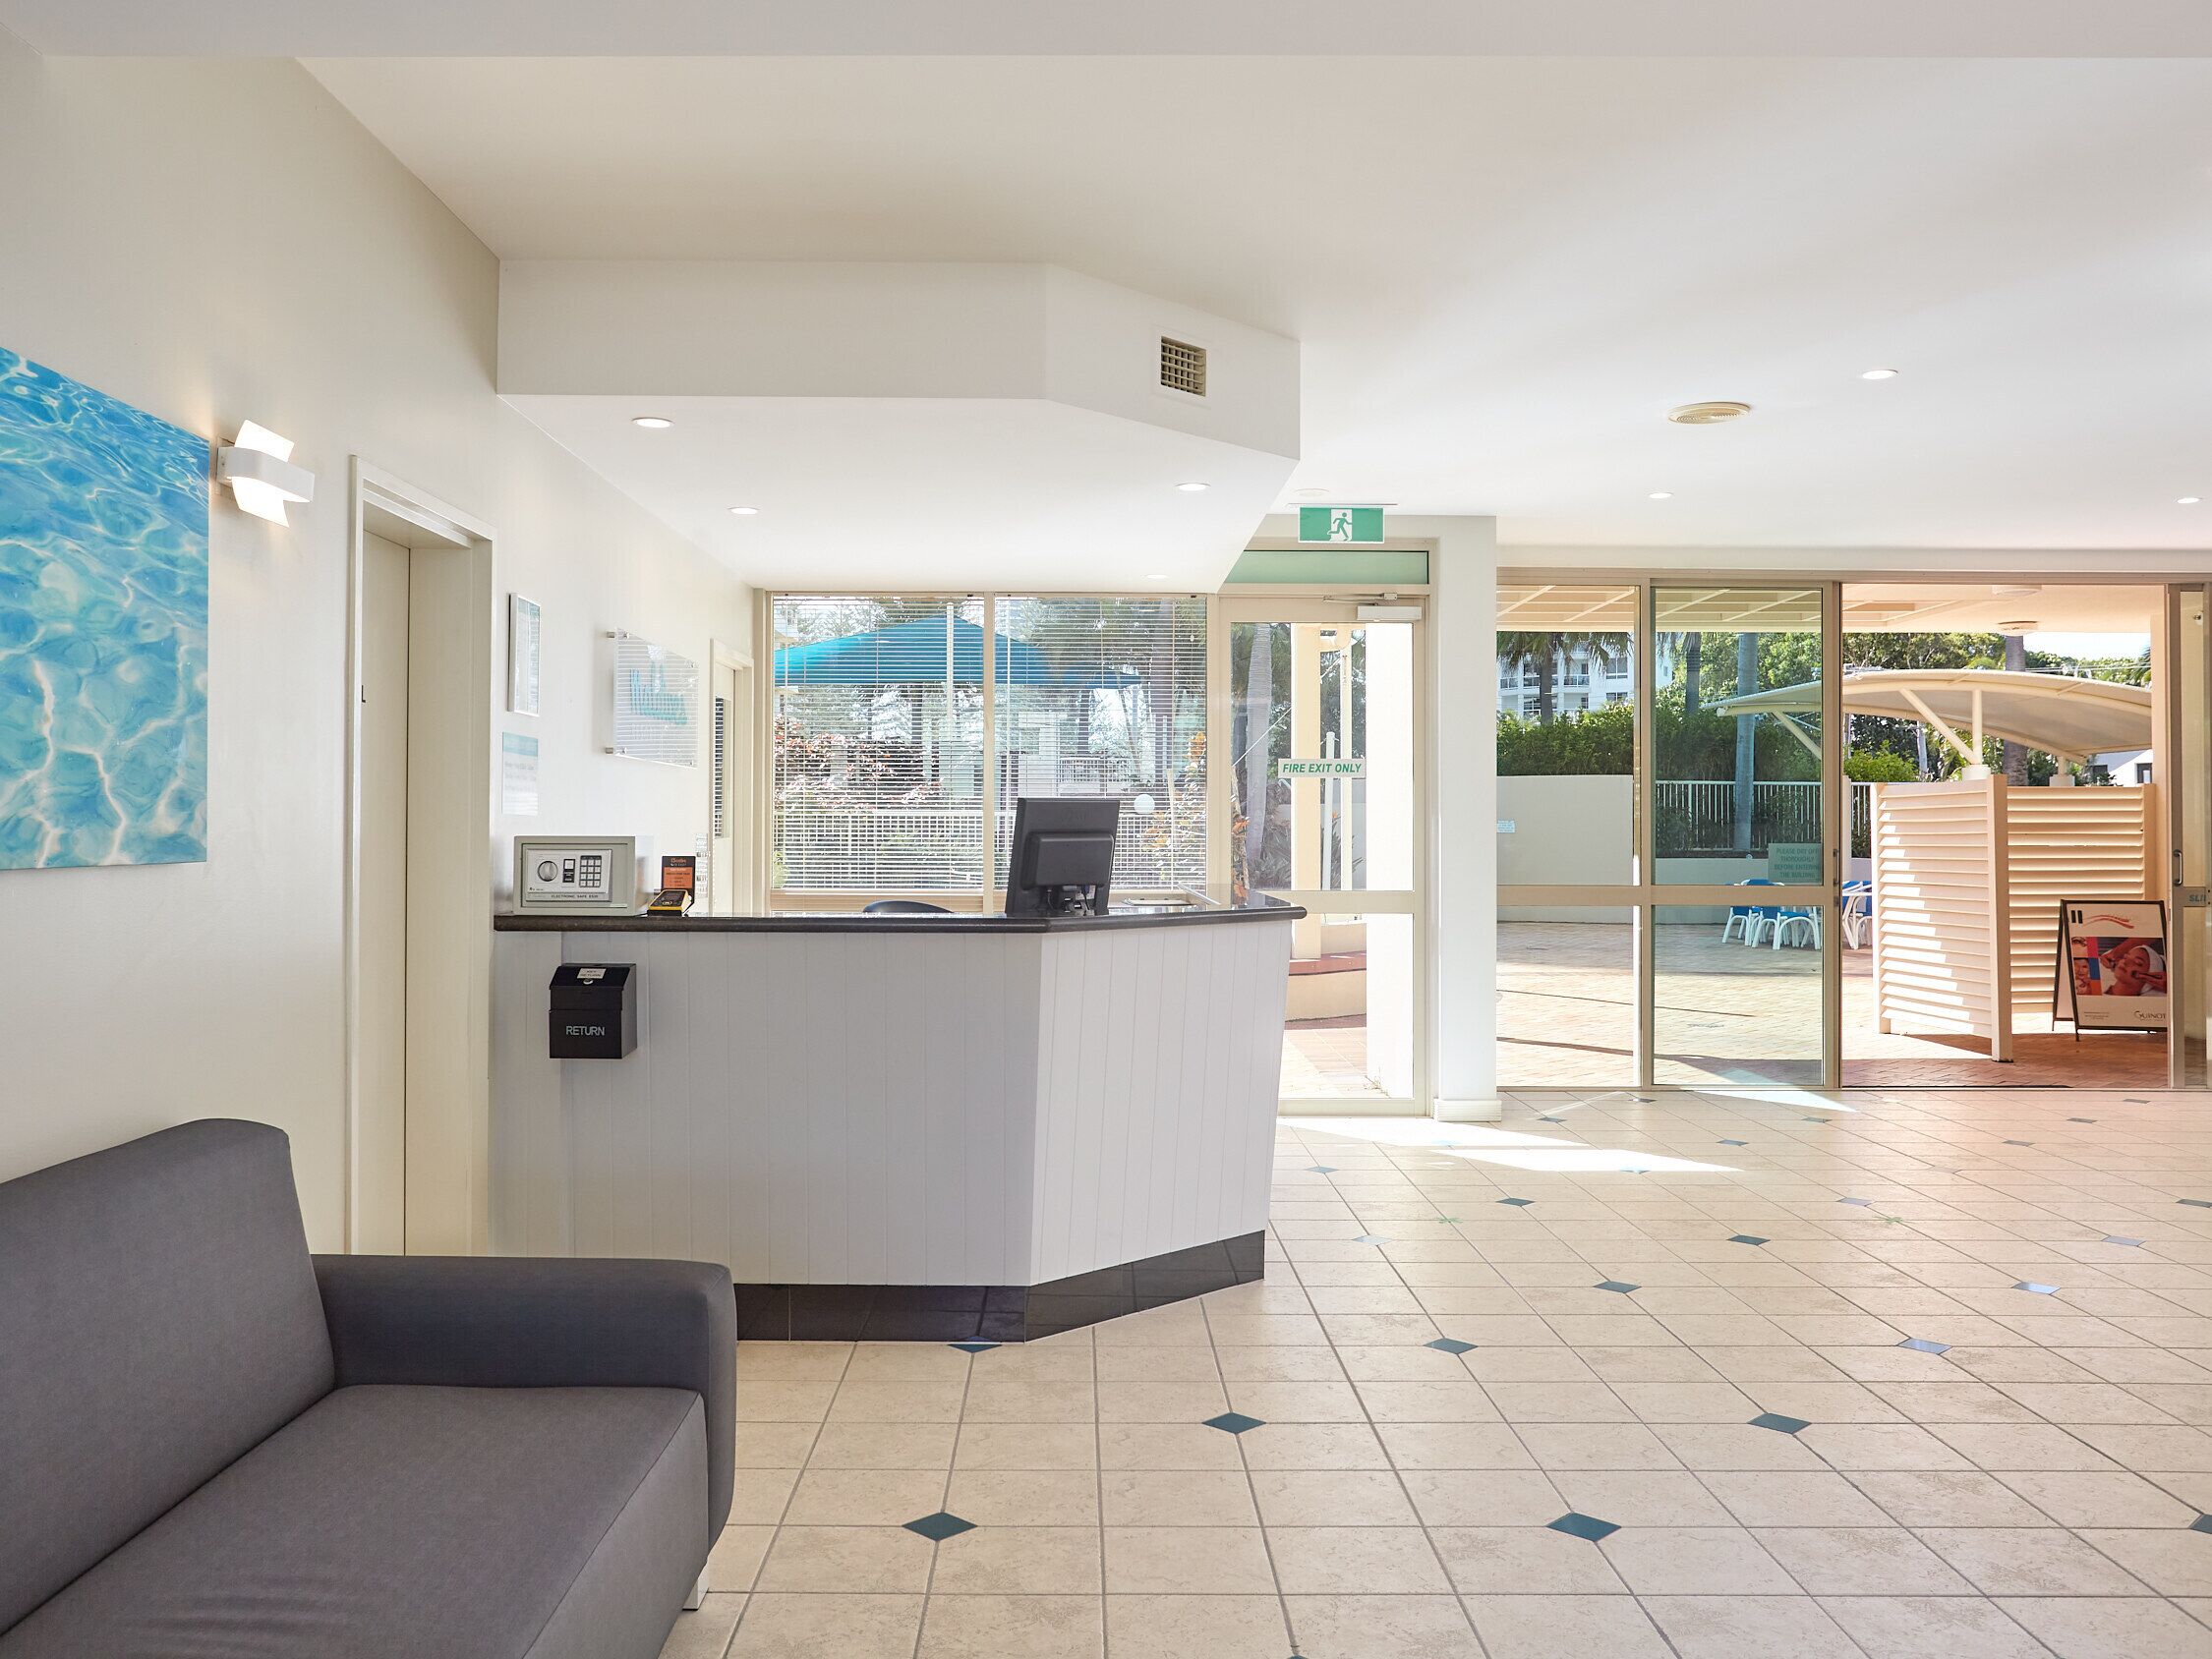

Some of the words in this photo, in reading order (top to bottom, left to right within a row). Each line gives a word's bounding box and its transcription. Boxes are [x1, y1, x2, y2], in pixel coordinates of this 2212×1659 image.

[1283, 764, 1305, 772] FIRE
[1309, 764, 1332, 772] EXIT
[1335, 764, 1362, 772] ONLY
[565, 1025, 606, 1036] RETURN
